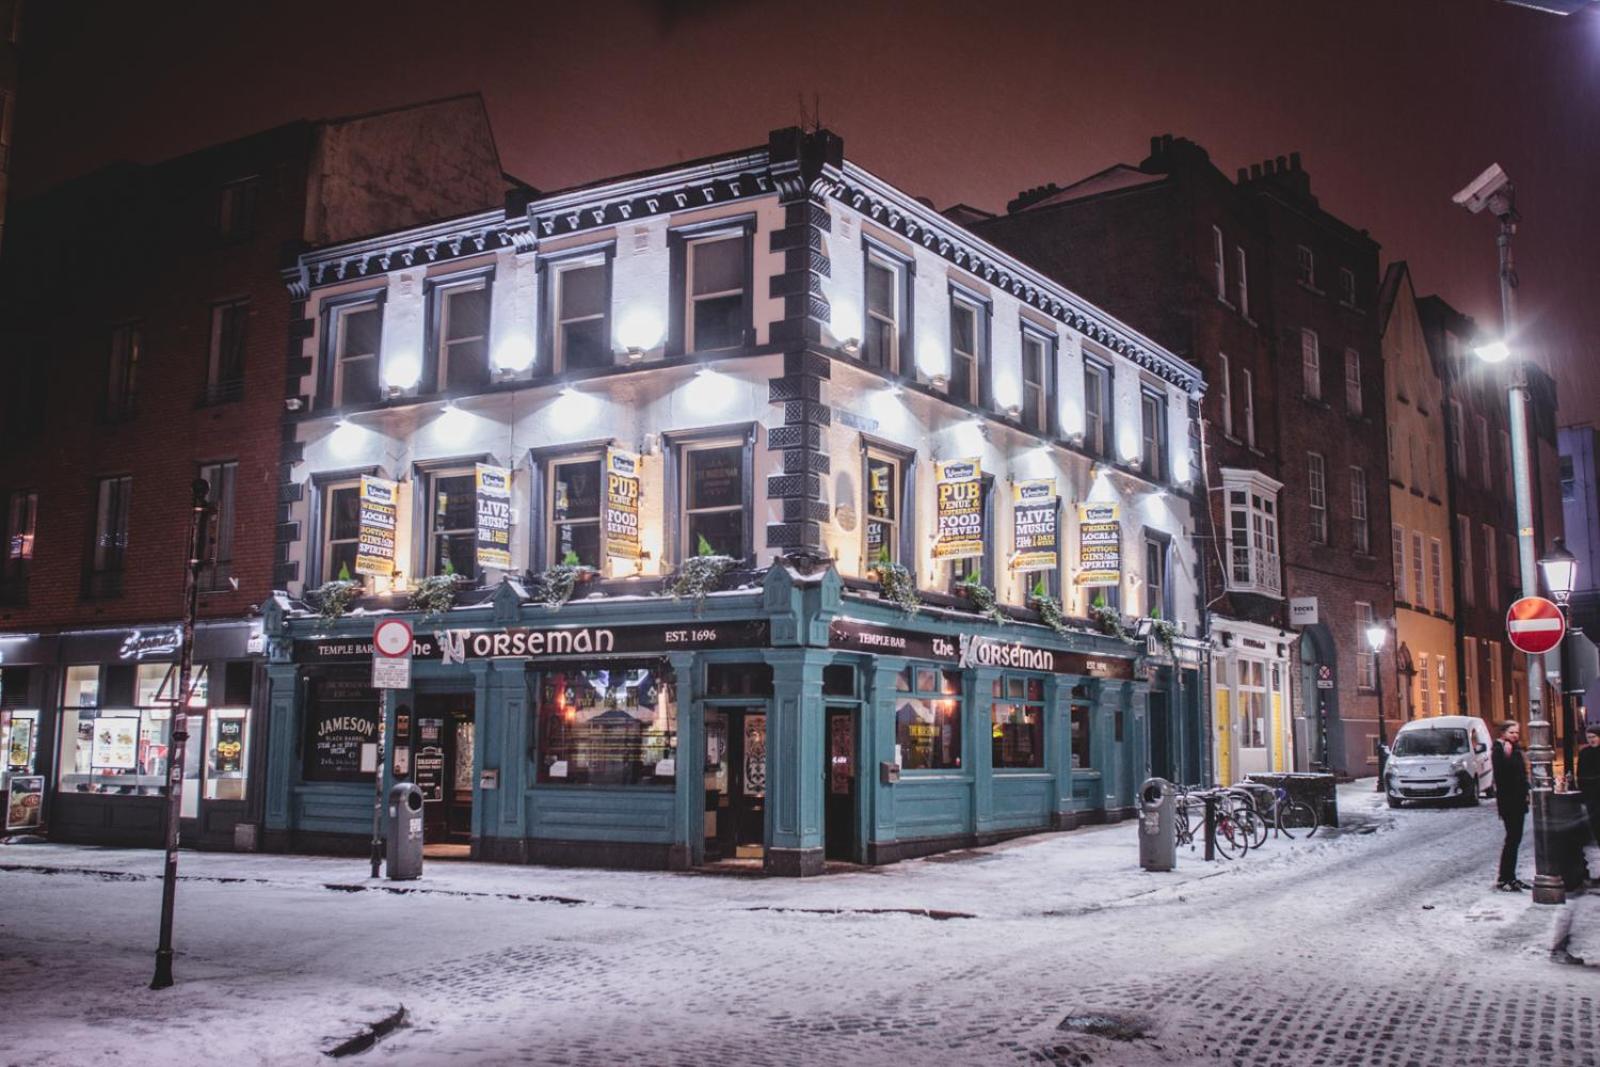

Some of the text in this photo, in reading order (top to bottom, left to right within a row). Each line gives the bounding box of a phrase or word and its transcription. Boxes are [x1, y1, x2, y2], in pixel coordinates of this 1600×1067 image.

[608, 474, 639, 498] PUB
[940, 482, 980, 501] PUB
[478, 499, 509, 518] LIVE
[940, 499, 972, 511] VENUE
[361, 510, 388, 523] LOCAL
[479, 515, 509, 530] MUSIC
[608, 509, 638, 527] FOOD
[940, 513, 980, 529] FOOD
[1016, 509, 1055, 525] LIVE
[608, 523, 638, 536] SERVED
[1016, 522, 1055, 535] MUSIC
[1082, 532, 1110, 541] LOCAL
[318, 644, 354, 656] TEMPLE
[355, 643, 375, 654] BAR
[412, 640, 432, 656] he
[665, 631, 688, 643] EST.
[691, 629, 717, 642] 1696
[859, 632, 890, 647] TEMPLE
[890, 636, 907, 649] BAR
[932, 638, 954, 657] The
[318, 716, 374, 737] JAMESON
